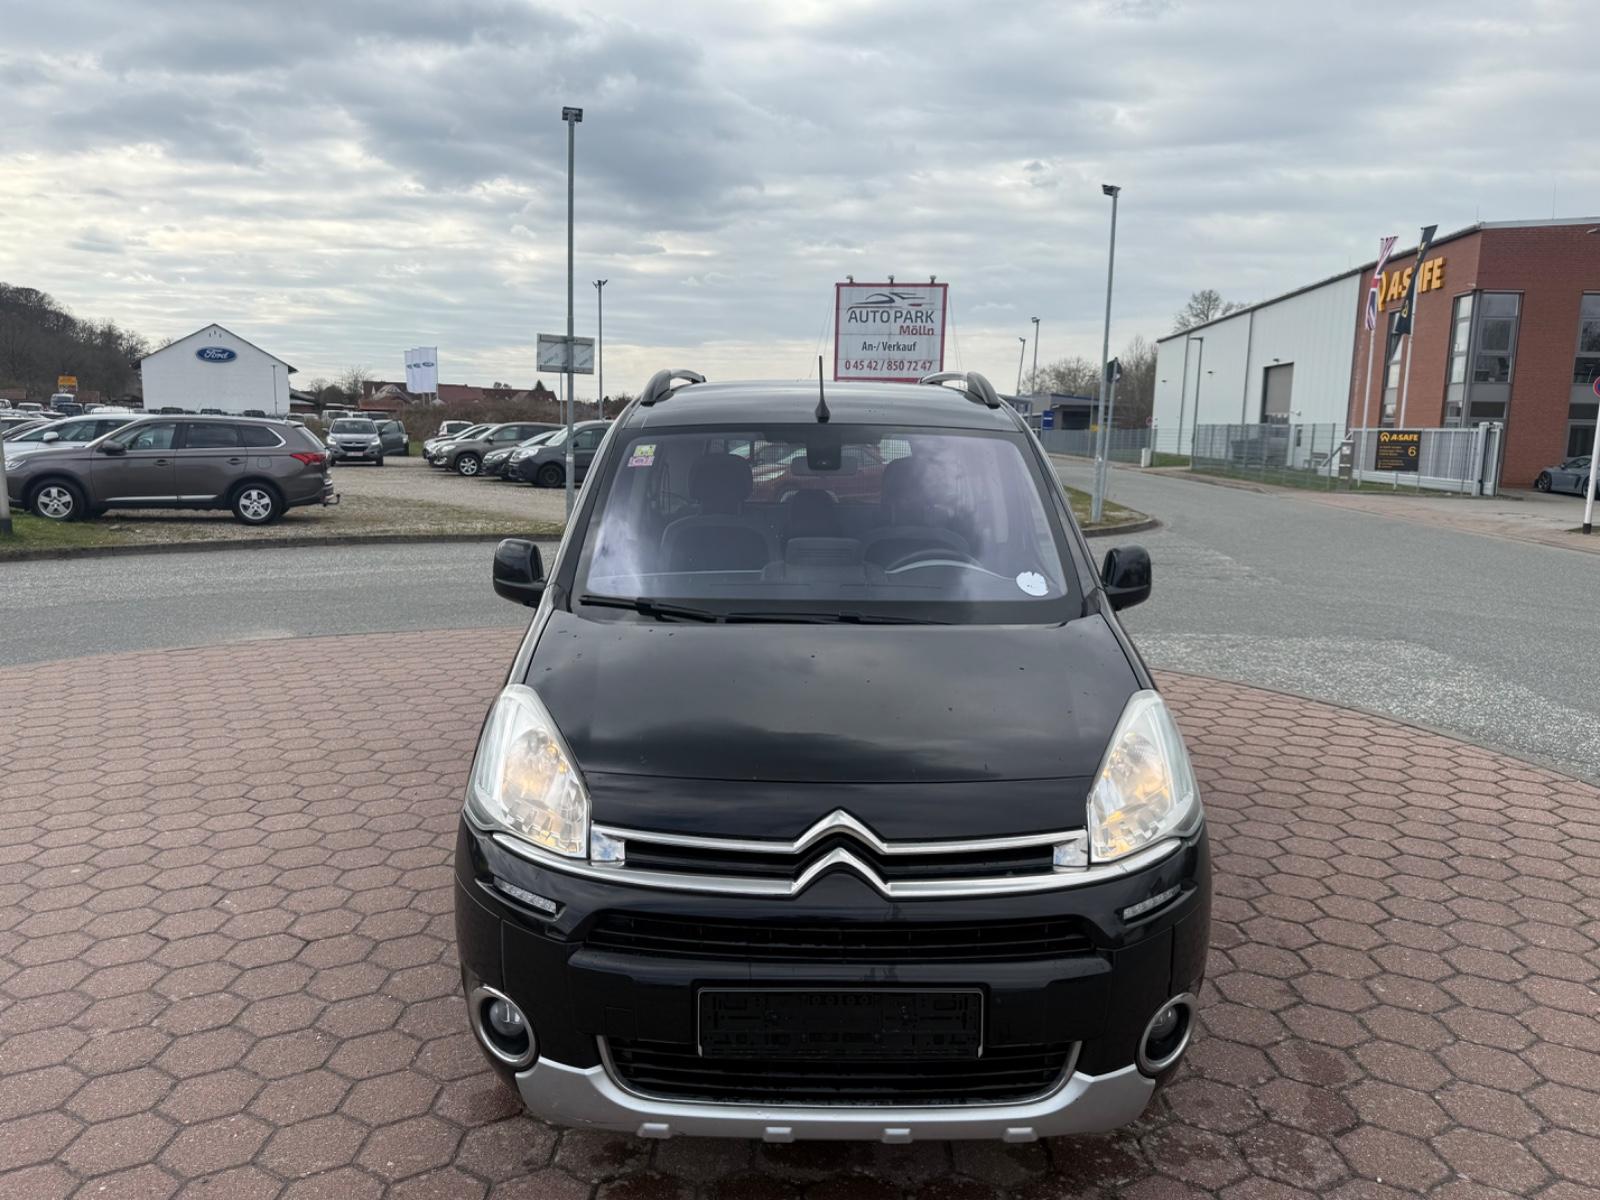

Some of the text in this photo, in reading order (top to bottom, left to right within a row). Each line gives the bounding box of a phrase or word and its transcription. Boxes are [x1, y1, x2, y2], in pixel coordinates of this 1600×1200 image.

[1386, 257, 1444, 301] A-SFE
[848, 310, 935, 323] AUTO PARK
[899, 325, 935, 336] Mölln
[882, 341, 917, 352] Verkauf
[204, 350, 229, 359] Ford
[1407, 446, 1417, 457] 6
